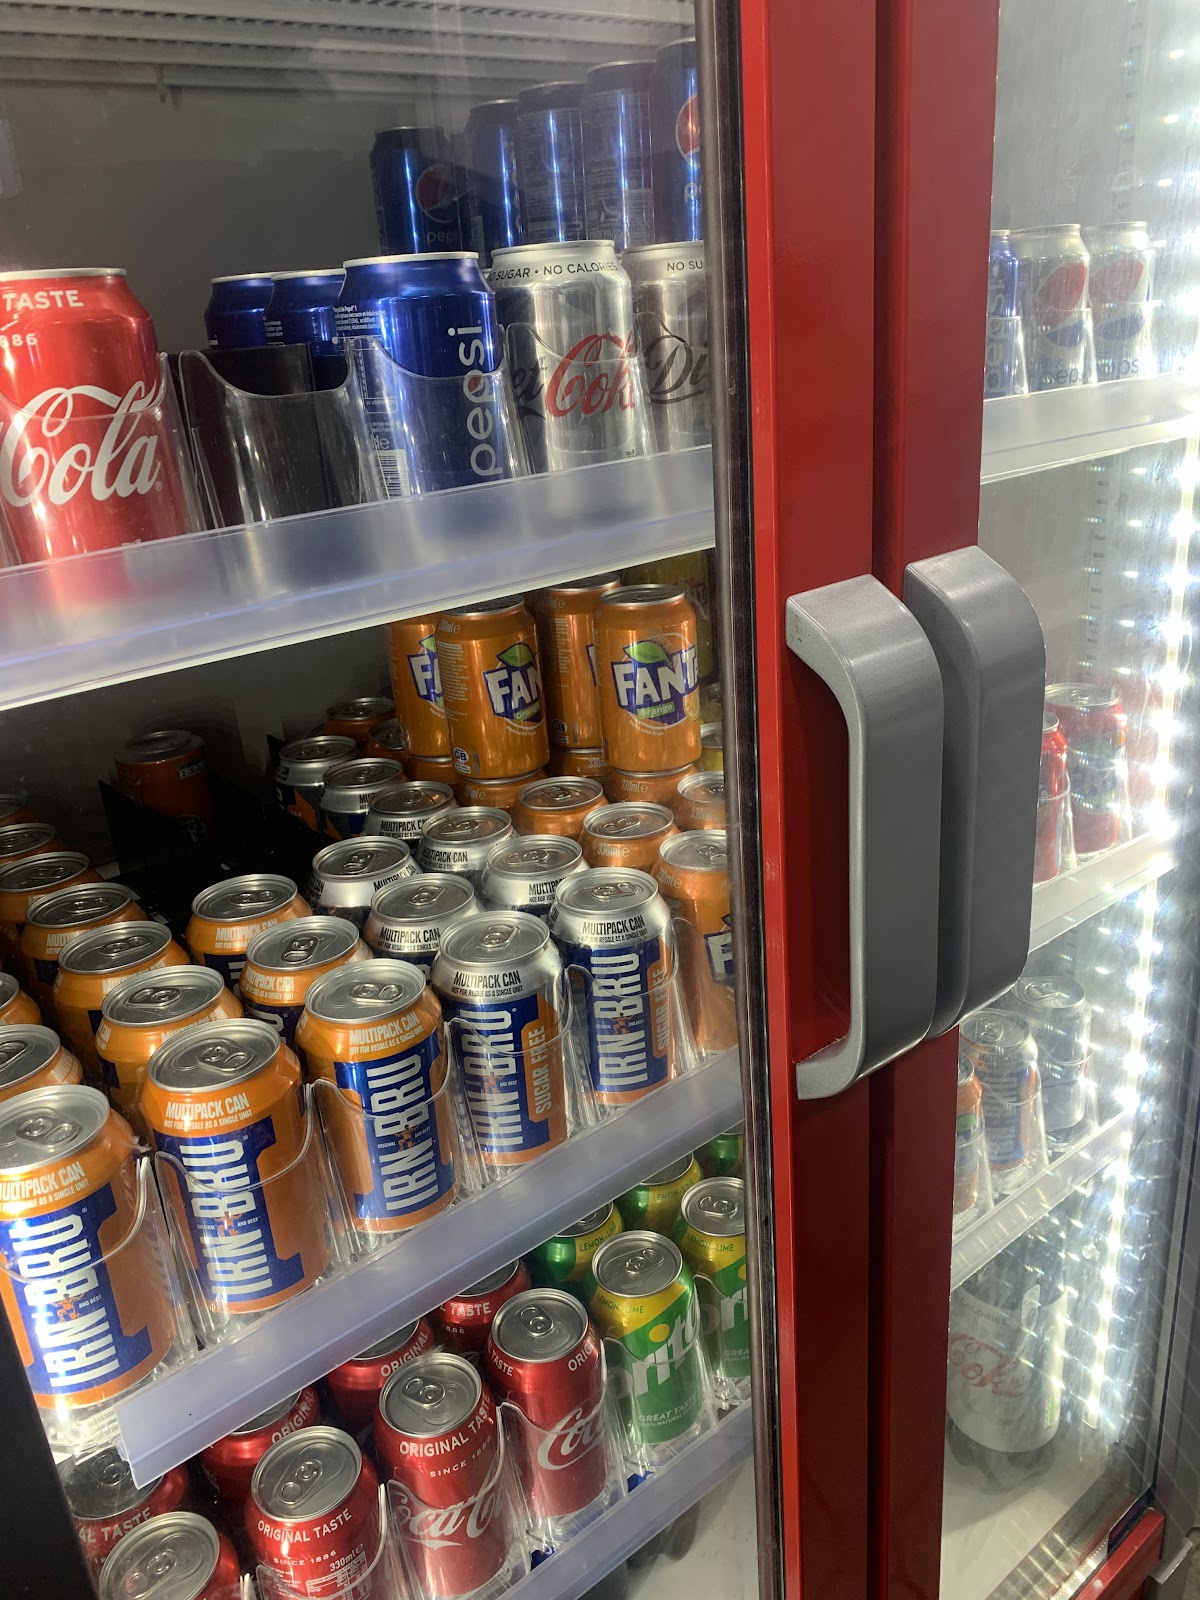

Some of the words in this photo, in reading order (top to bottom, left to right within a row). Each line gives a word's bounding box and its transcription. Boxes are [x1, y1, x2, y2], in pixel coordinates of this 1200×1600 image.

[495, 267, 530, 280] SUGAR
[543, 264, 563, 275] NO
[567, 261, 618, 274] CALORIES
[666, 261, 685, 271] NO
[4, 289, 84, 312] TASTE
[448, 326, 502, 476] pepsi
[484, 664, 542, 715] FAN
[454, 749, 467, 761] GB
[380, 820, 417, 832] MULTIPACK
[453, 851, 468, 863] CAN
[529, 877, 567, 896] MULTIP
[582, 919, 629, 936] MULTIPACK
[629, 915, 646, 931] CAN
[380, 927, 421, 944] MULTIPACK
[423, 927, 441, 943] CAN
[599, 935, 615, 943] RESALE
[276, 976, 294, 992] CAN
[453, 971, 501, 989] MULTIPACK
[502, 970, 522, 987] CAN
[652, 965, 669, 1004] FREE
[459, 988, 468, 996] FOR
[496, 988, 511, 997] SINGLE
[349, 1020, 402, 1045] MULTIPACK
[401, 1010, 420, 1030] CAN
[656, 1007, 671, 1051] SUGAR
[349, 1047, 359, 1055] NOT
[371, 1042, 389, 1052] RESALE
[389, 1039, 396, 1047] AS
[400, 1031, 415, 1043] SINGLE
[528, 1025, 548, 1064] FREE
[532, 1063, 552, 1115] SUGAR
[165, 1099, 224, 1120] MULTIPACK
[225, 1092, 249, 1114] CAN
[164, 1119, 173, 1128] NOT
[205, 1119, 213, 1129] AS
[214, 1118, 219, 1127] A
[219, 1114, 239, 1126] SINGLE
[240, 1109, 252, 1121] UNIT
[58, 1161, 85, 1187] CAN
[39, 1195, 47, 1205] AS
[49, 1194, 53, 1203] A
[54, 1187, 75, 1201] SINGLE
[75, 1178, 89, 1191] UNIT
[237, 1219, 248, 1227] AND
[248, 1217, 259, 1225] BEST
[79, 1298, 90, 1309] AND
[90, 1294, 102, 1306] BEST
[450, 1301, 491, 1316] TASTE
[723, 1349, 749, 1357] GREA
[491, 1350, 514, 1377] TASTE
[400, 1432, 469, 1458] ORIGINAL
[468, 1392, 491, 1432] TASTE
[639, 1410, 672, 1422] GREAT
[429, 1460, 467, 1477] SINCE
[257, 1520, 311, 1543] ORIGINAL
[313, 1508, 352, 1539] TASTE
[273, 1557, 306, 1566] SINCE
[310, 1550, 337, 1564] 1886
